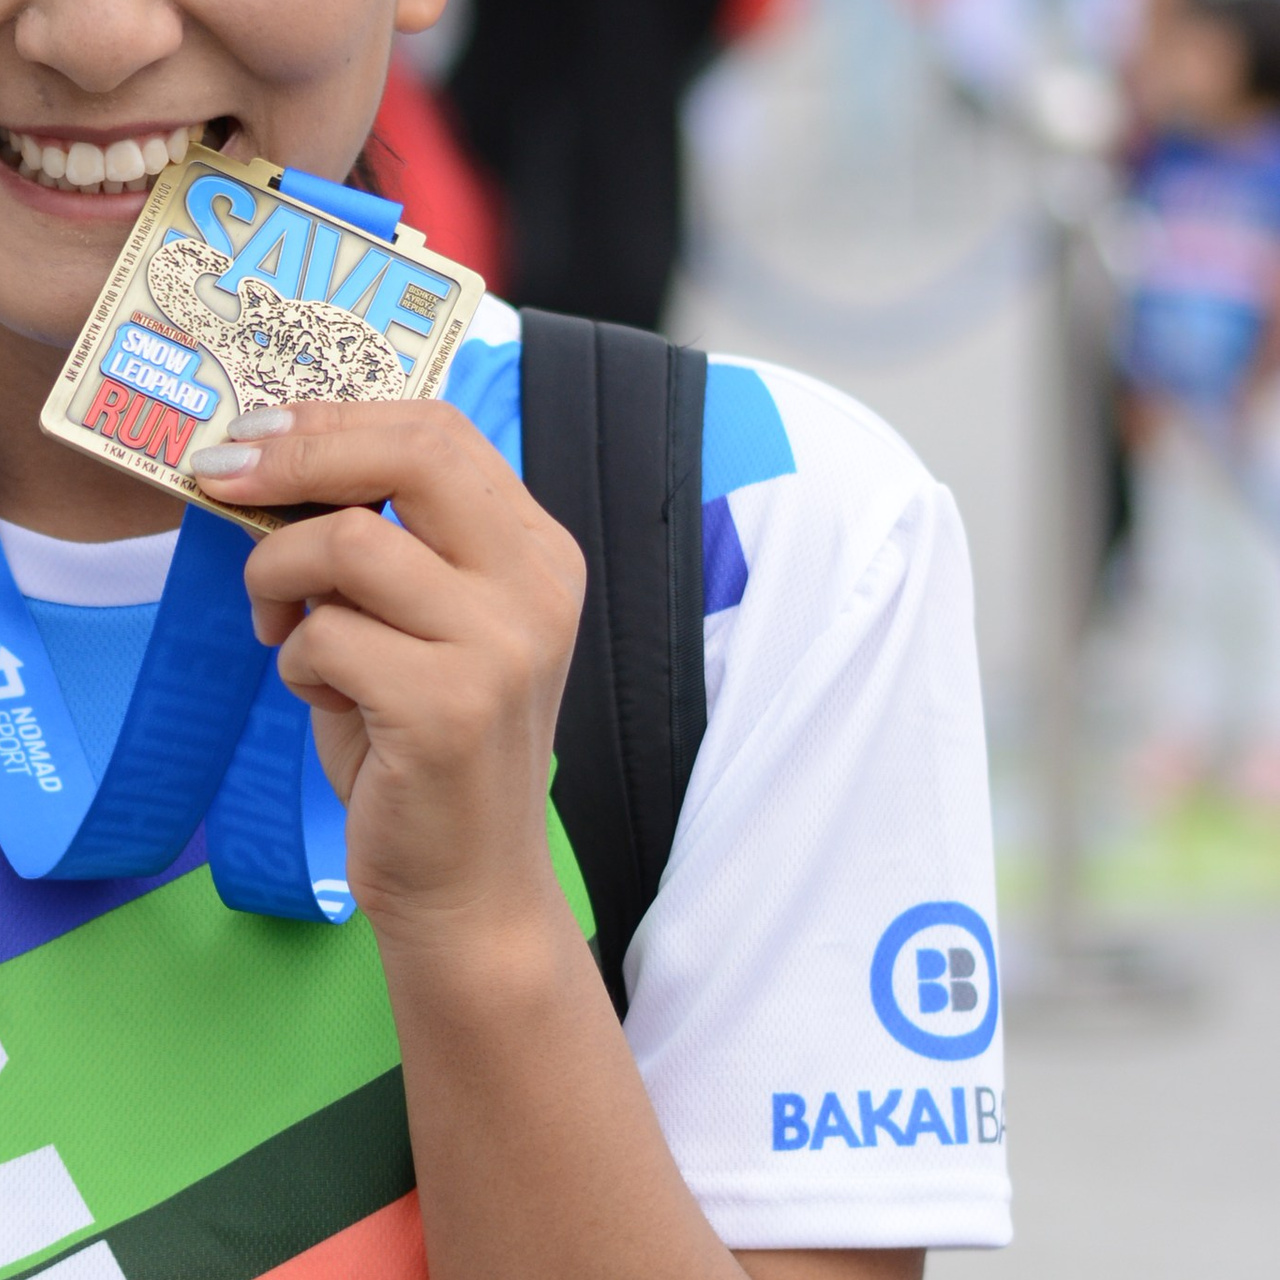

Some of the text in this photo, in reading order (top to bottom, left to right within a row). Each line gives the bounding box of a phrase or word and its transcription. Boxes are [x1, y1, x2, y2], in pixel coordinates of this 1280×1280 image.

[65, 372, 79, 383] АК
[73, 323, 102, 368] ИЛБИРСТИ
[95, 290, 118, 322] КОРГОО
[123, 251, 137, 265] ЭЛ
[130, 215, 155, 253] АРАЛЫК
[401, 299, 435, 319] REPUBLIC
[405, 292, 435, 310] KYRGYZ
[408, 285, 439, 303] BISHKEK
[121, 327, 192, 376] SNOW
[132, 311, 199, 349] INTERNATIONAL
[109, 350, 210, 413] LEOPARD
[418, 381, 435, 400] ЗАБЕ
[82, 378, 198, 468] RUN
[11, 707, 62, 792] NOMAD
